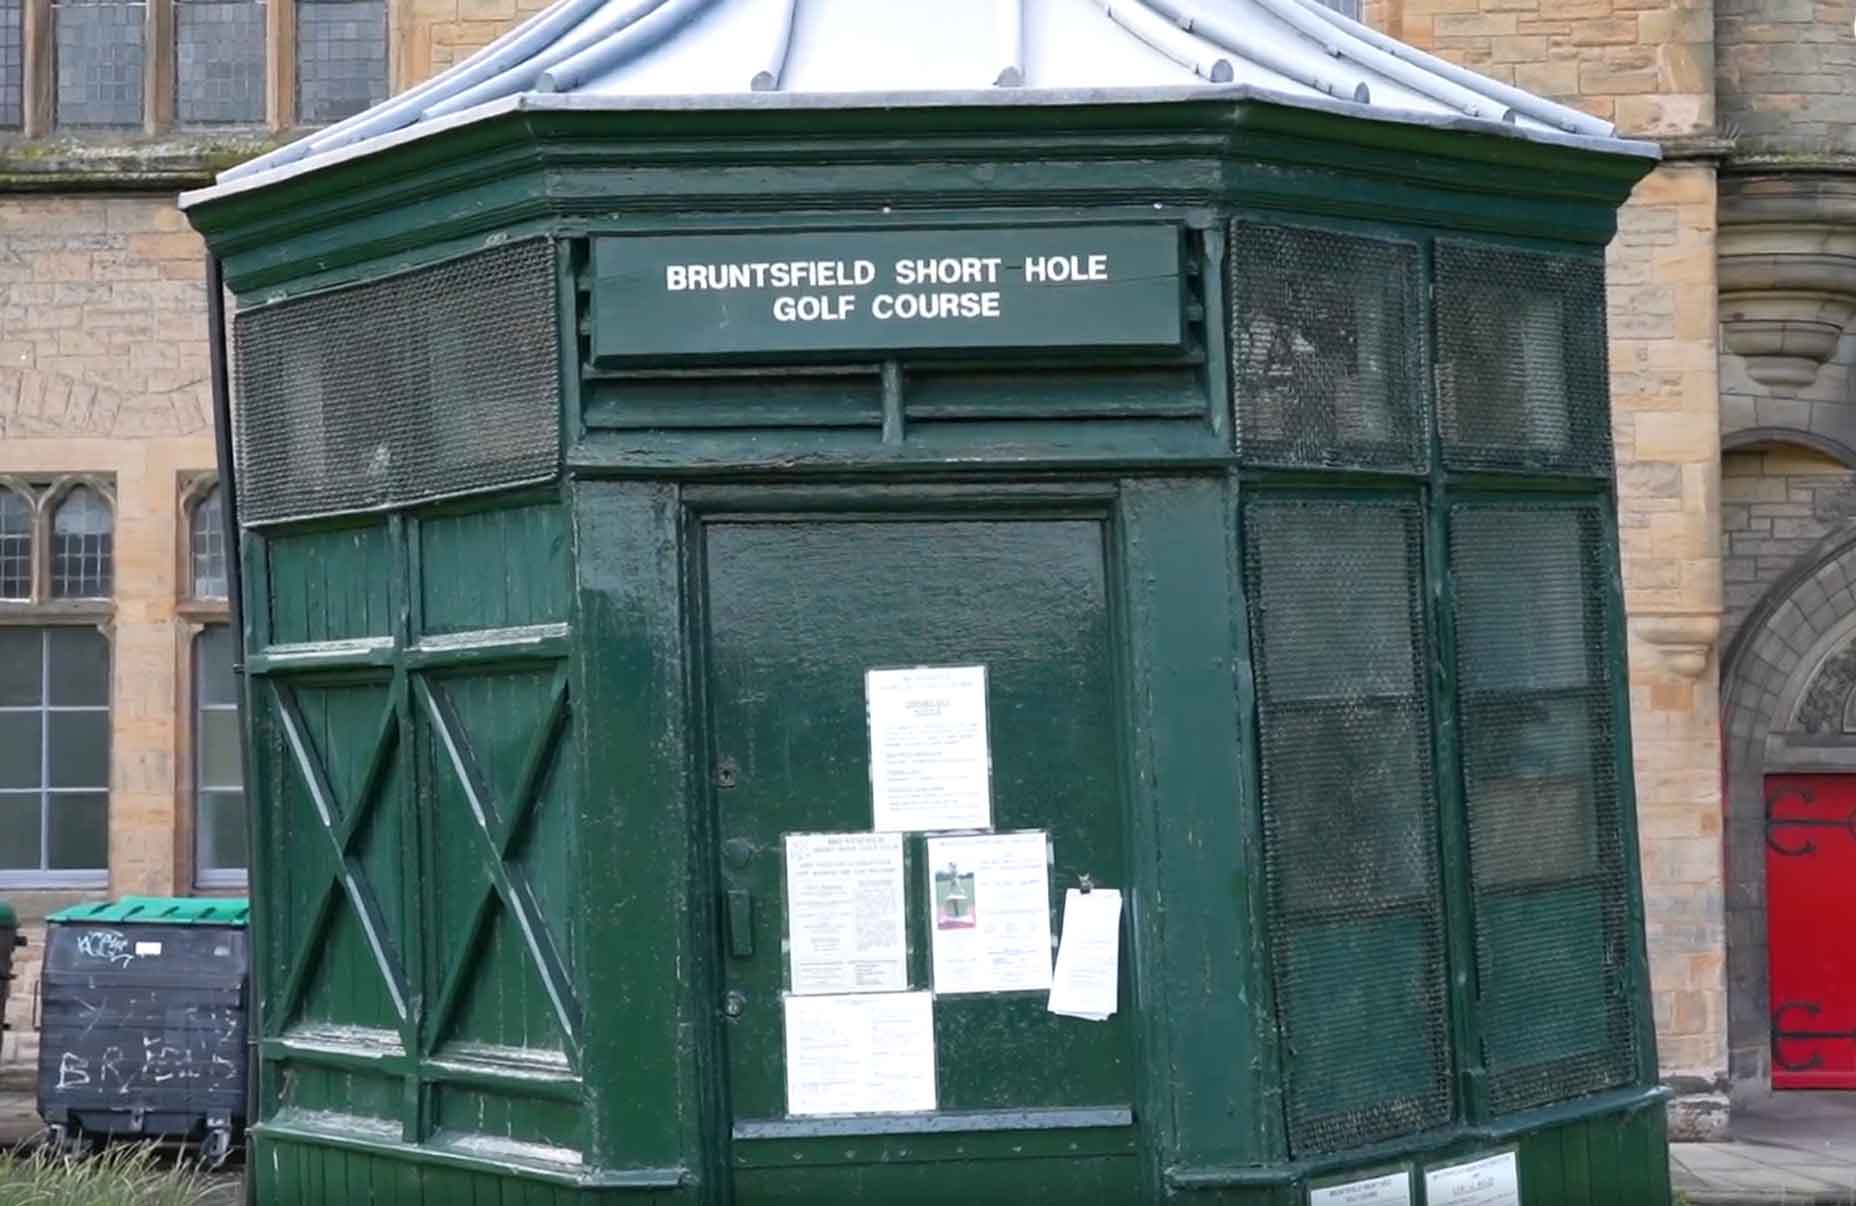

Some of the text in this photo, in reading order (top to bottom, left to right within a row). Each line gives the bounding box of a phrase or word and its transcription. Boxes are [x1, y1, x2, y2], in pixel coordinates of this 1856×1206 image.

[666, 254, 1109, 291] BRUNTSFIELD SHORT HOLE
[772, 291, 1001, 322] GOLF COURSE
